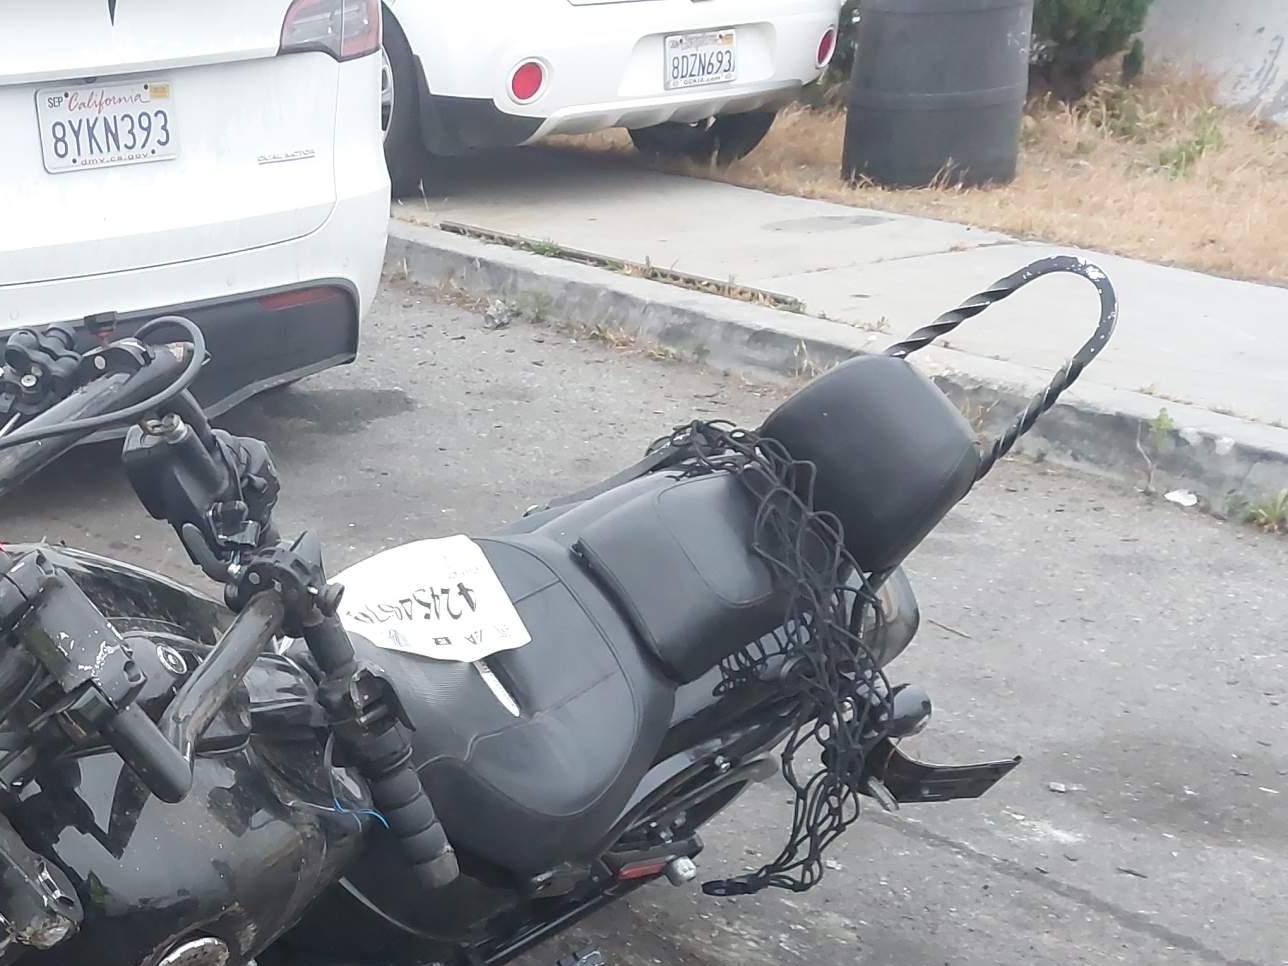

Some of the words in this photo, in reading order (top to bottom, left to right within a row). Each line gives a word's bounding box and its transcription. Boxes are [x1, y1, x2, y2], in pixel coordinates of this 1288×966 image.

[672, 50, 732, 79] 8DZN693
[47, 96, 63, 109] SEP
[68, 90, 150, 114] California
[52, 110, 170, 158] 8YKN393
[80, 153, 149, 166] dmv.ca.gov
